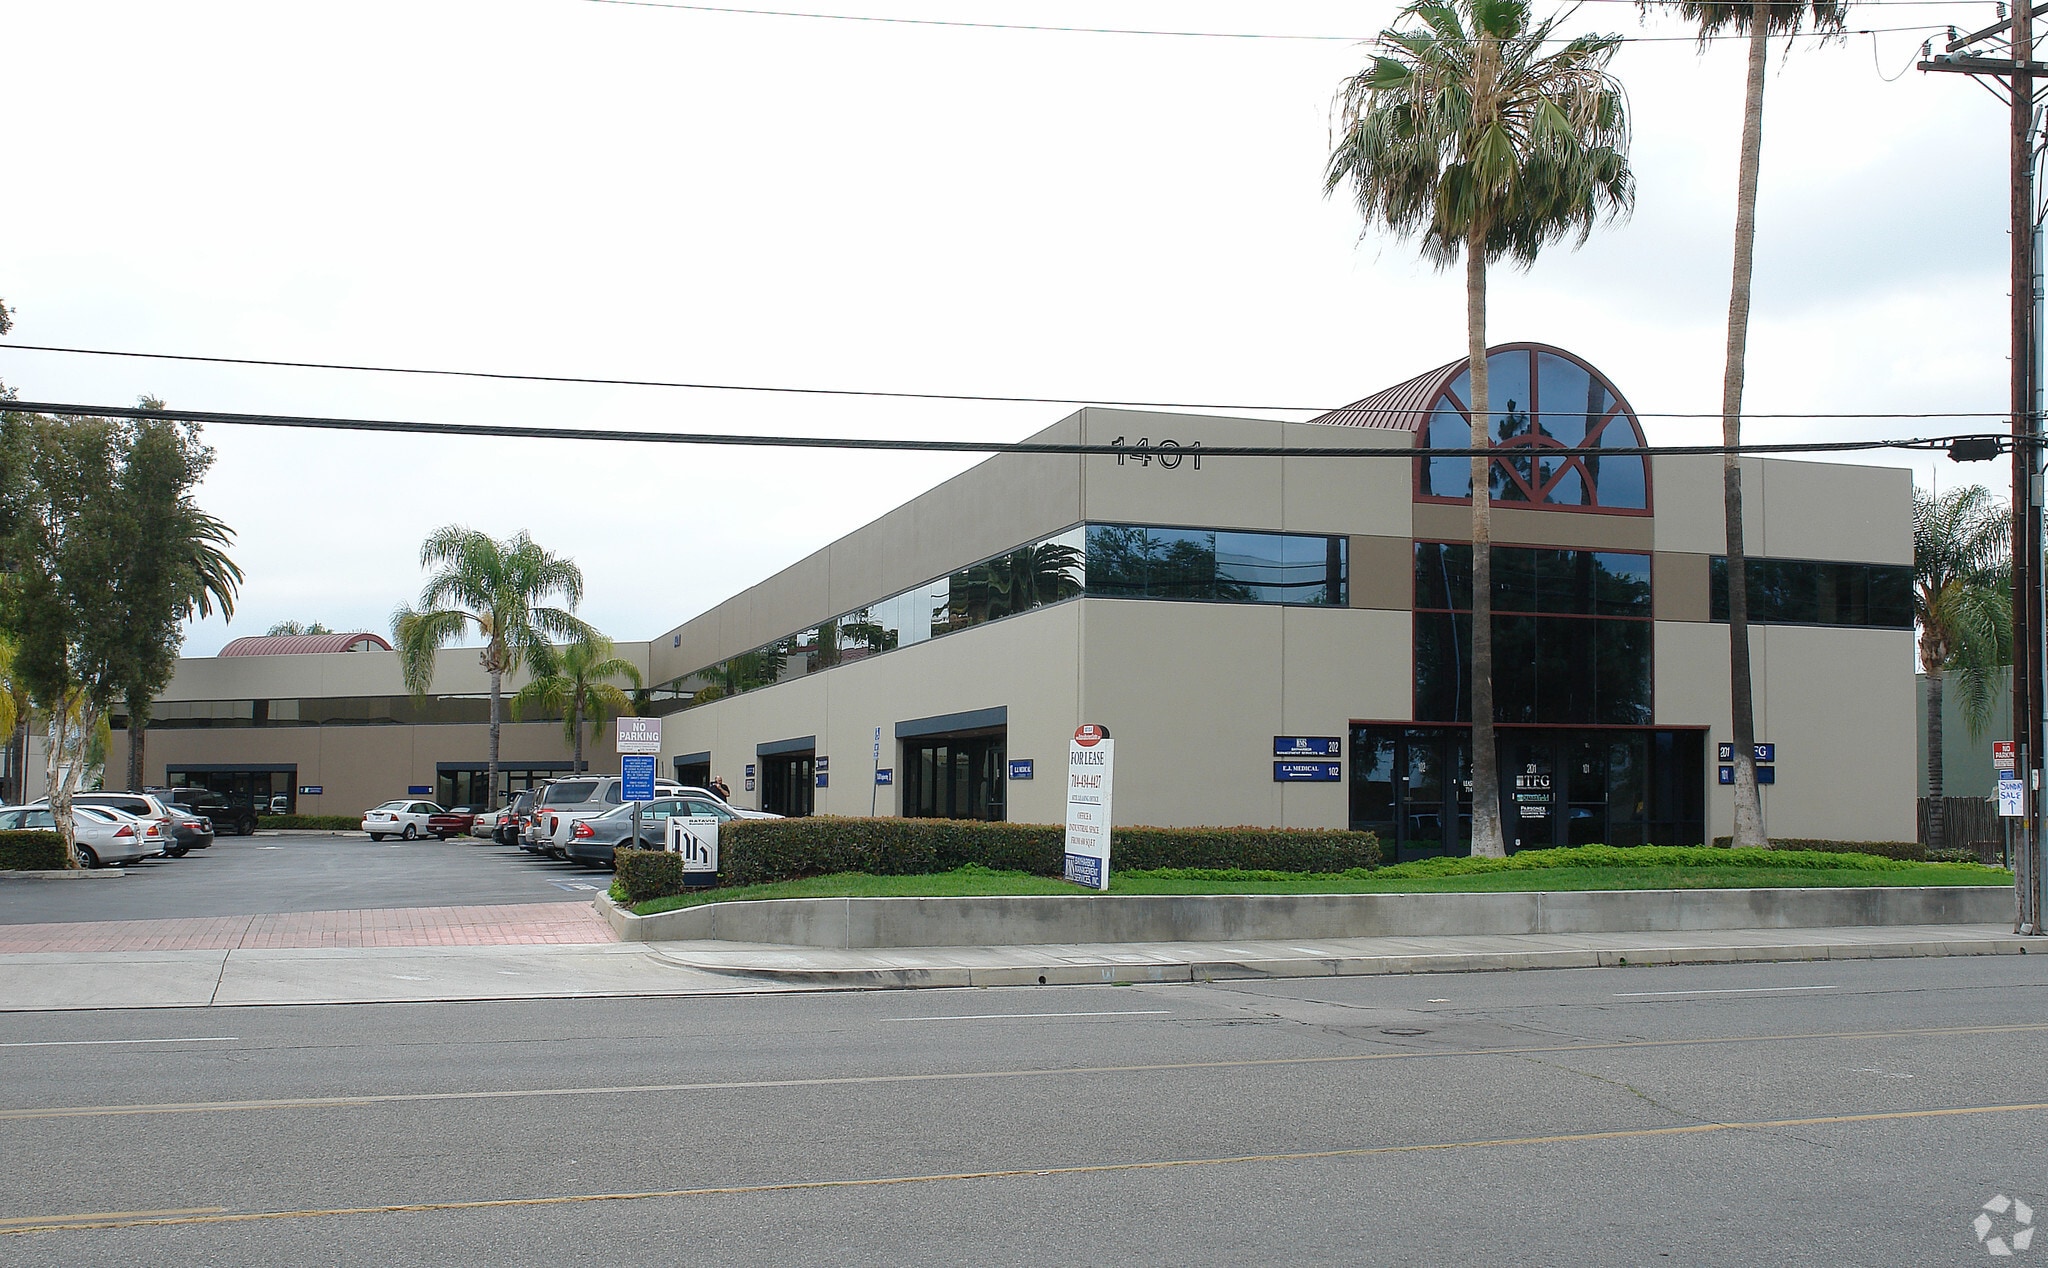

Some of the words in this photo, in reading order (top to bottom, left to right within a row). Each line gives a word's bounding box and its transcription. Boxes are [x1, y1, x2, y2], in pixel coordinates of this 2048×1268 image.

[1111, 436, 1200, 470] 1401
[632, 722, 646, 732] NO
[620, 731, 659, 741] PARKING
[1328, 741, 1339, 753] 202
[1720, 746, 1730, 757] 201
[1071, 751, 1083, 765] FOR
[1084, 751, 1104, 765] LEASE
[1328, 766, 1339, 776] 102
[1527, 763, 1537, 774] 201
[1524, 774, 1550, 787] TFG
[2000, 791, 2021, 800] SALE
